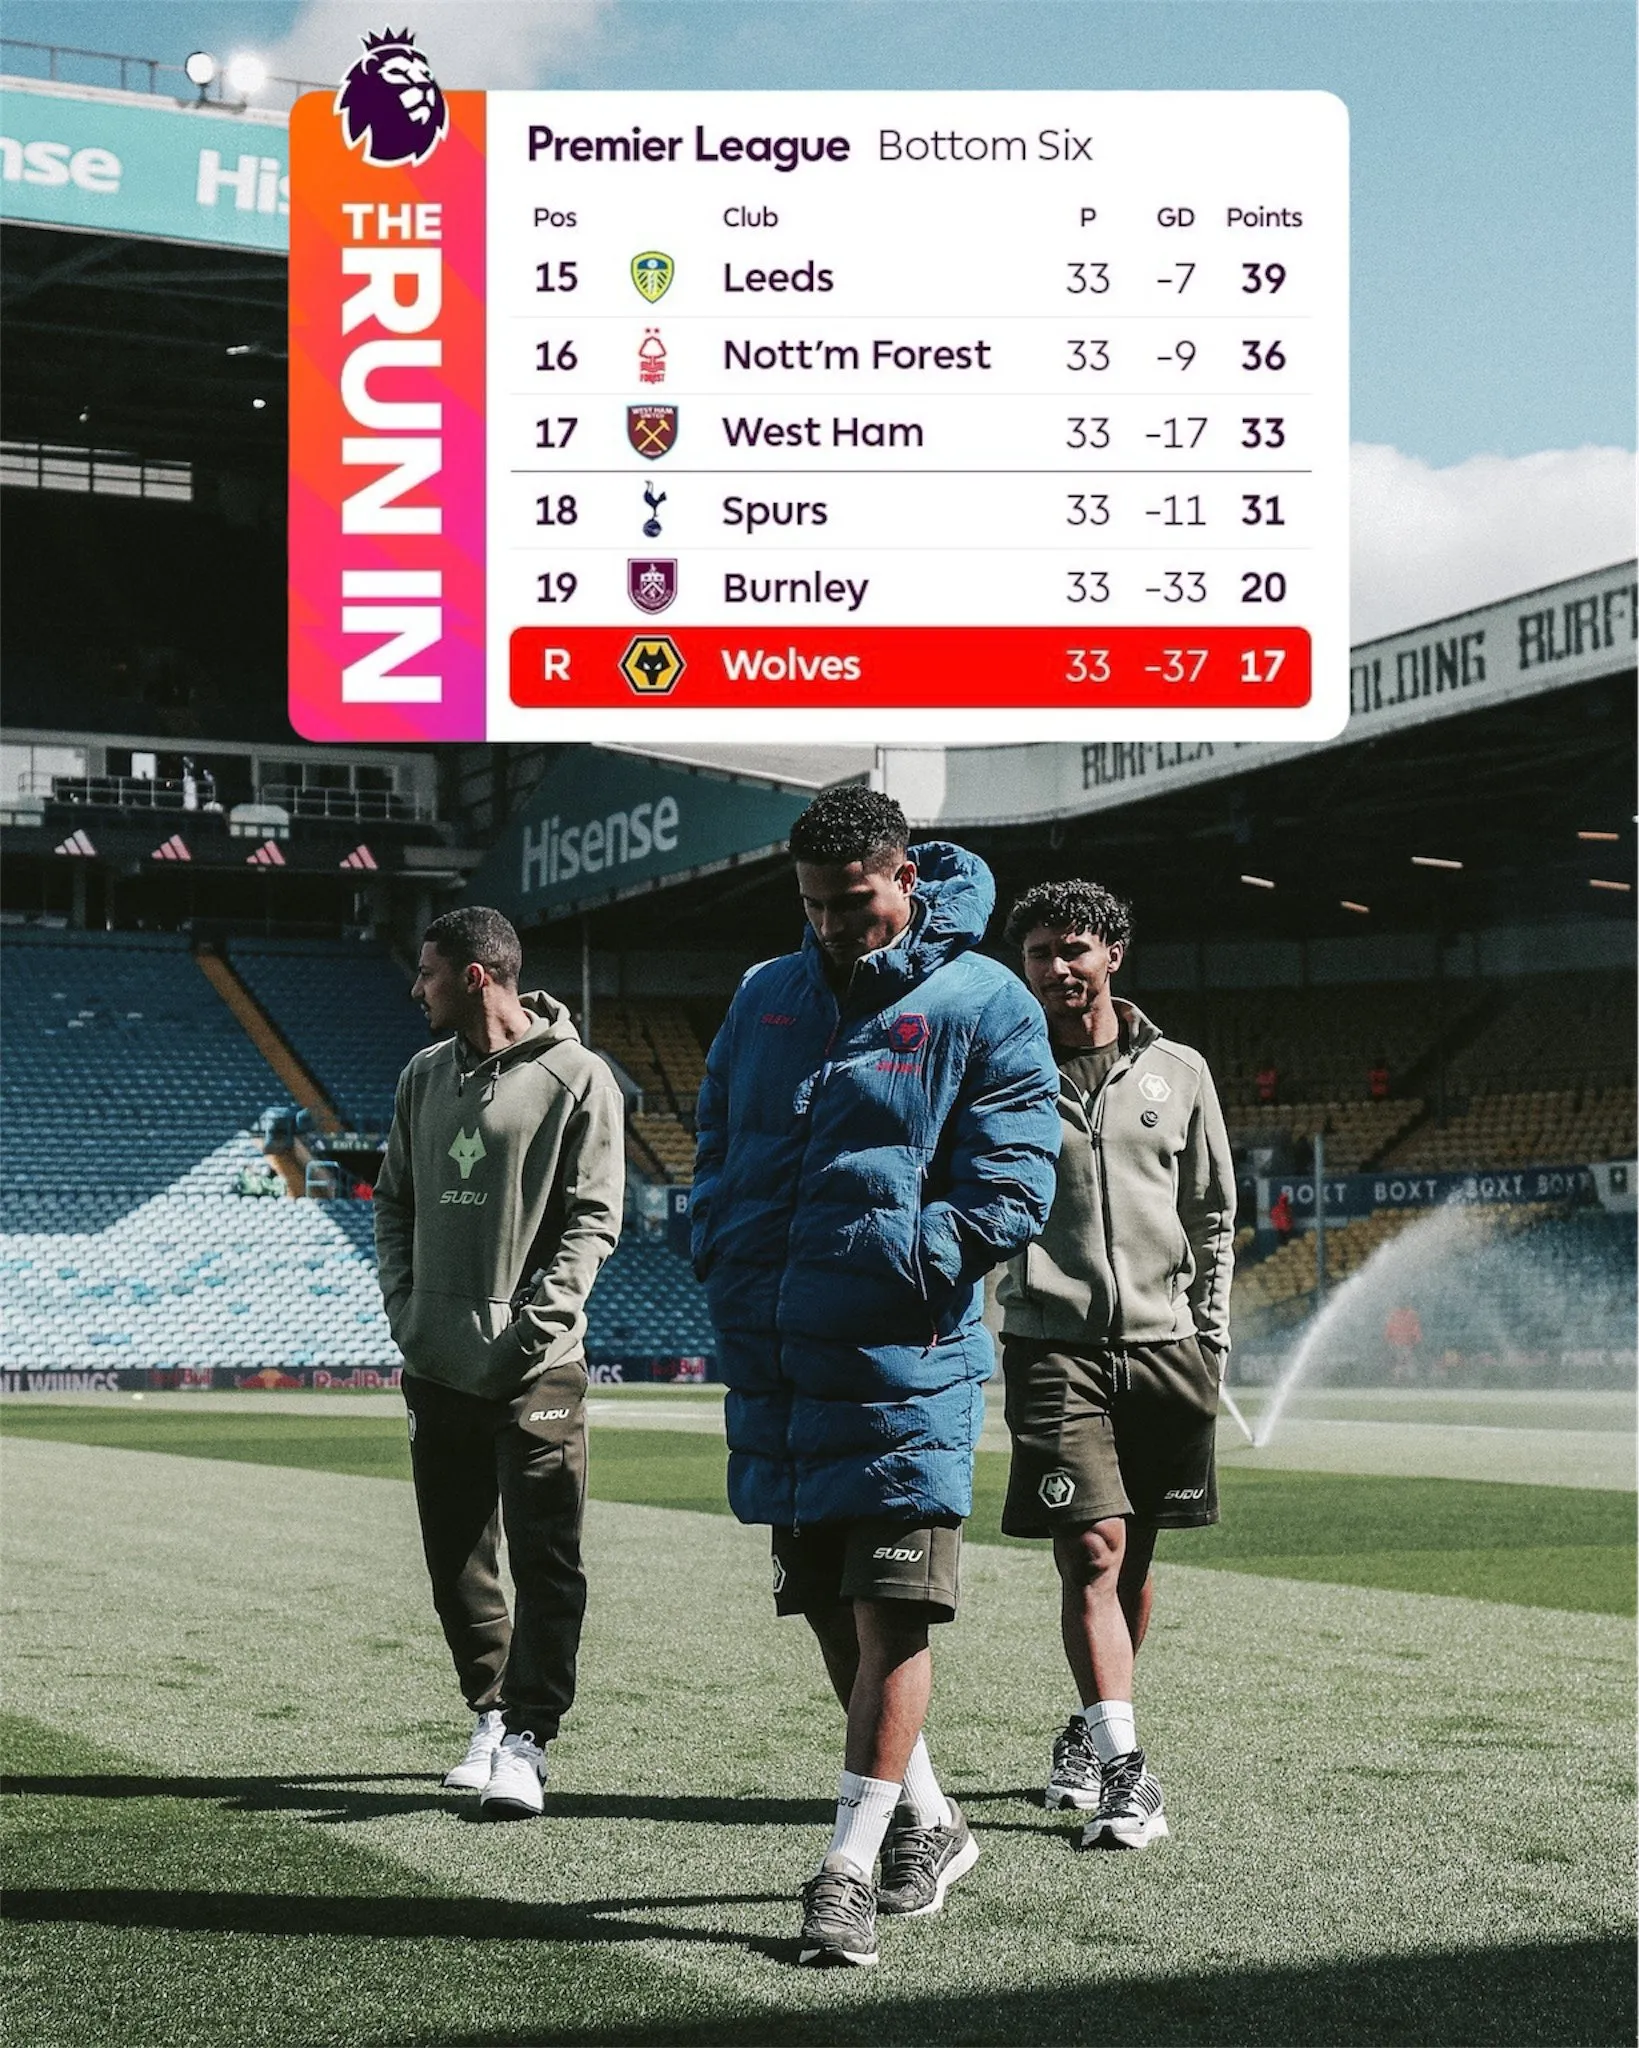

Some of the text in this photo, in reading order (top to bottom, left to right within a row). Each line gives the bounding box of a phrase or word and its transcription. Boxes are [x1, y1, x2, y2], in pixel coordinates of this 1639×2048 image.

[521, 796, 679, 893] Hisense
[439, 1189, 488, 1205] SUDU
[1374, 1179, 1437, 1202] BOXT
[529, 1408, 570, 1421] SUDU
[1163, 1488, 1205, 1500] SUDU
[872, 1546, 924, 1563] SUDU
